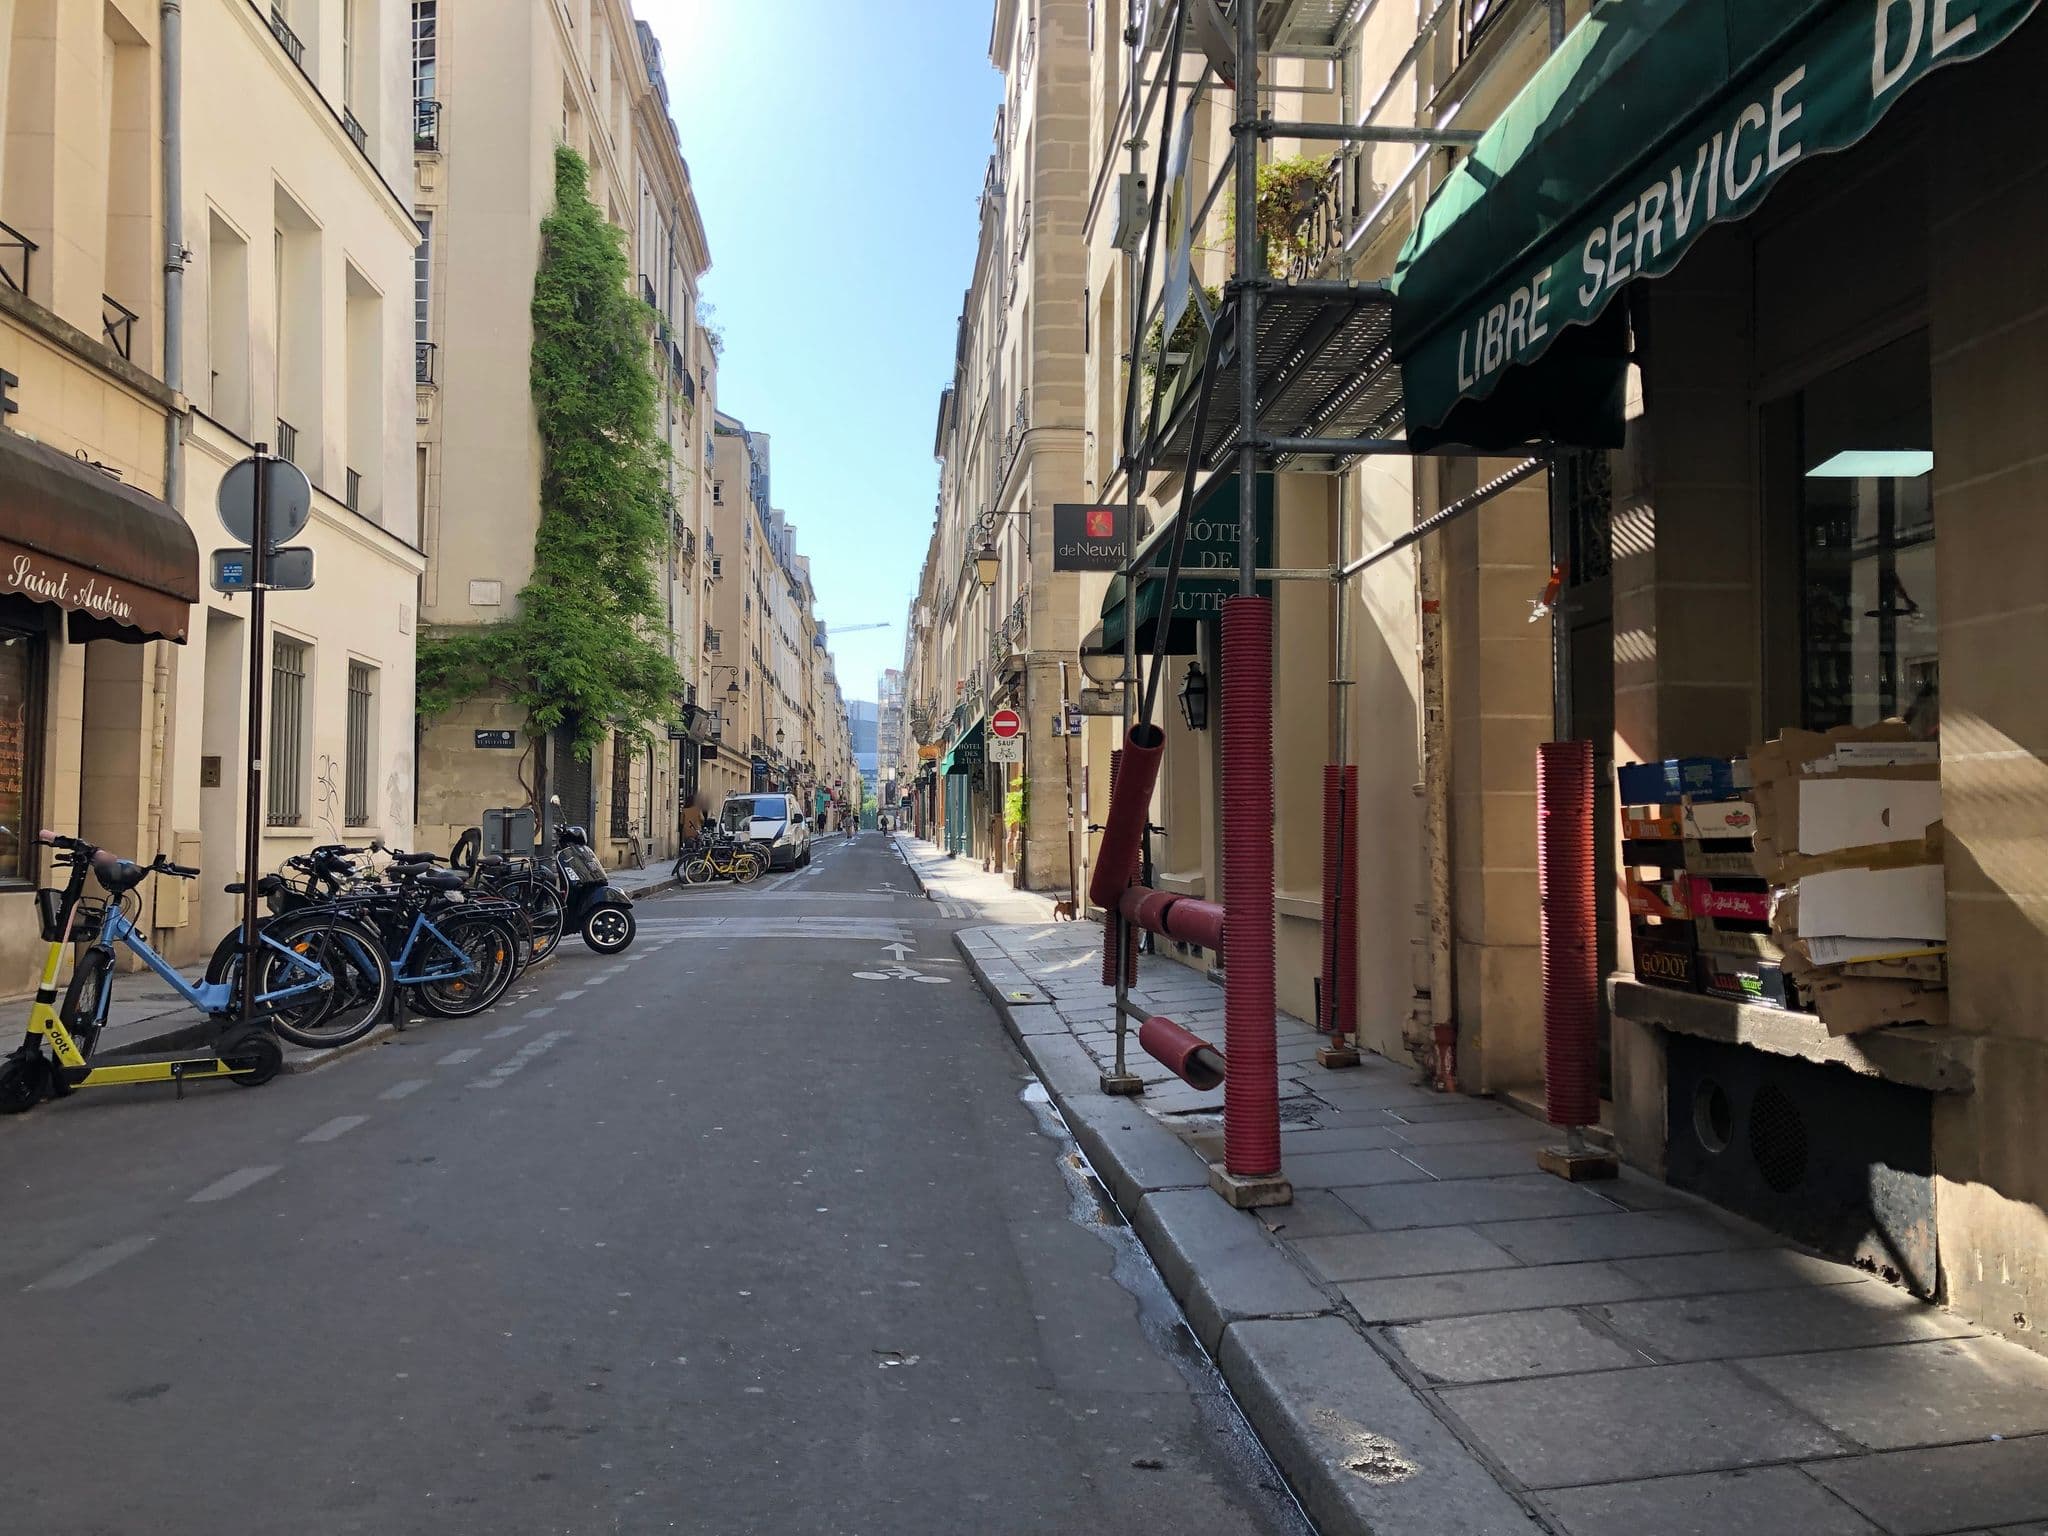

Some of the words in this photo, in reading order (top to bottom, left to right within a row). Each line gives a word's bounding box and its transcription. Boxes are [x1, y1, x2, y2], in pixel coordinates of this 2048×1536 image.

[1457, 265, 1552, 393] LIBRE
[1578, 64, 1806, 307] SERVICE
[1200, 551, 1233, 568] DE
[7, 555, 69, 600] Saint
[73, 578, 133, 618] Aubin
[958, 742, 981, 750] HÔTEL
[1641, 953, 1688, 978] GODOY
[51, 1031, 70, 1055] dott
